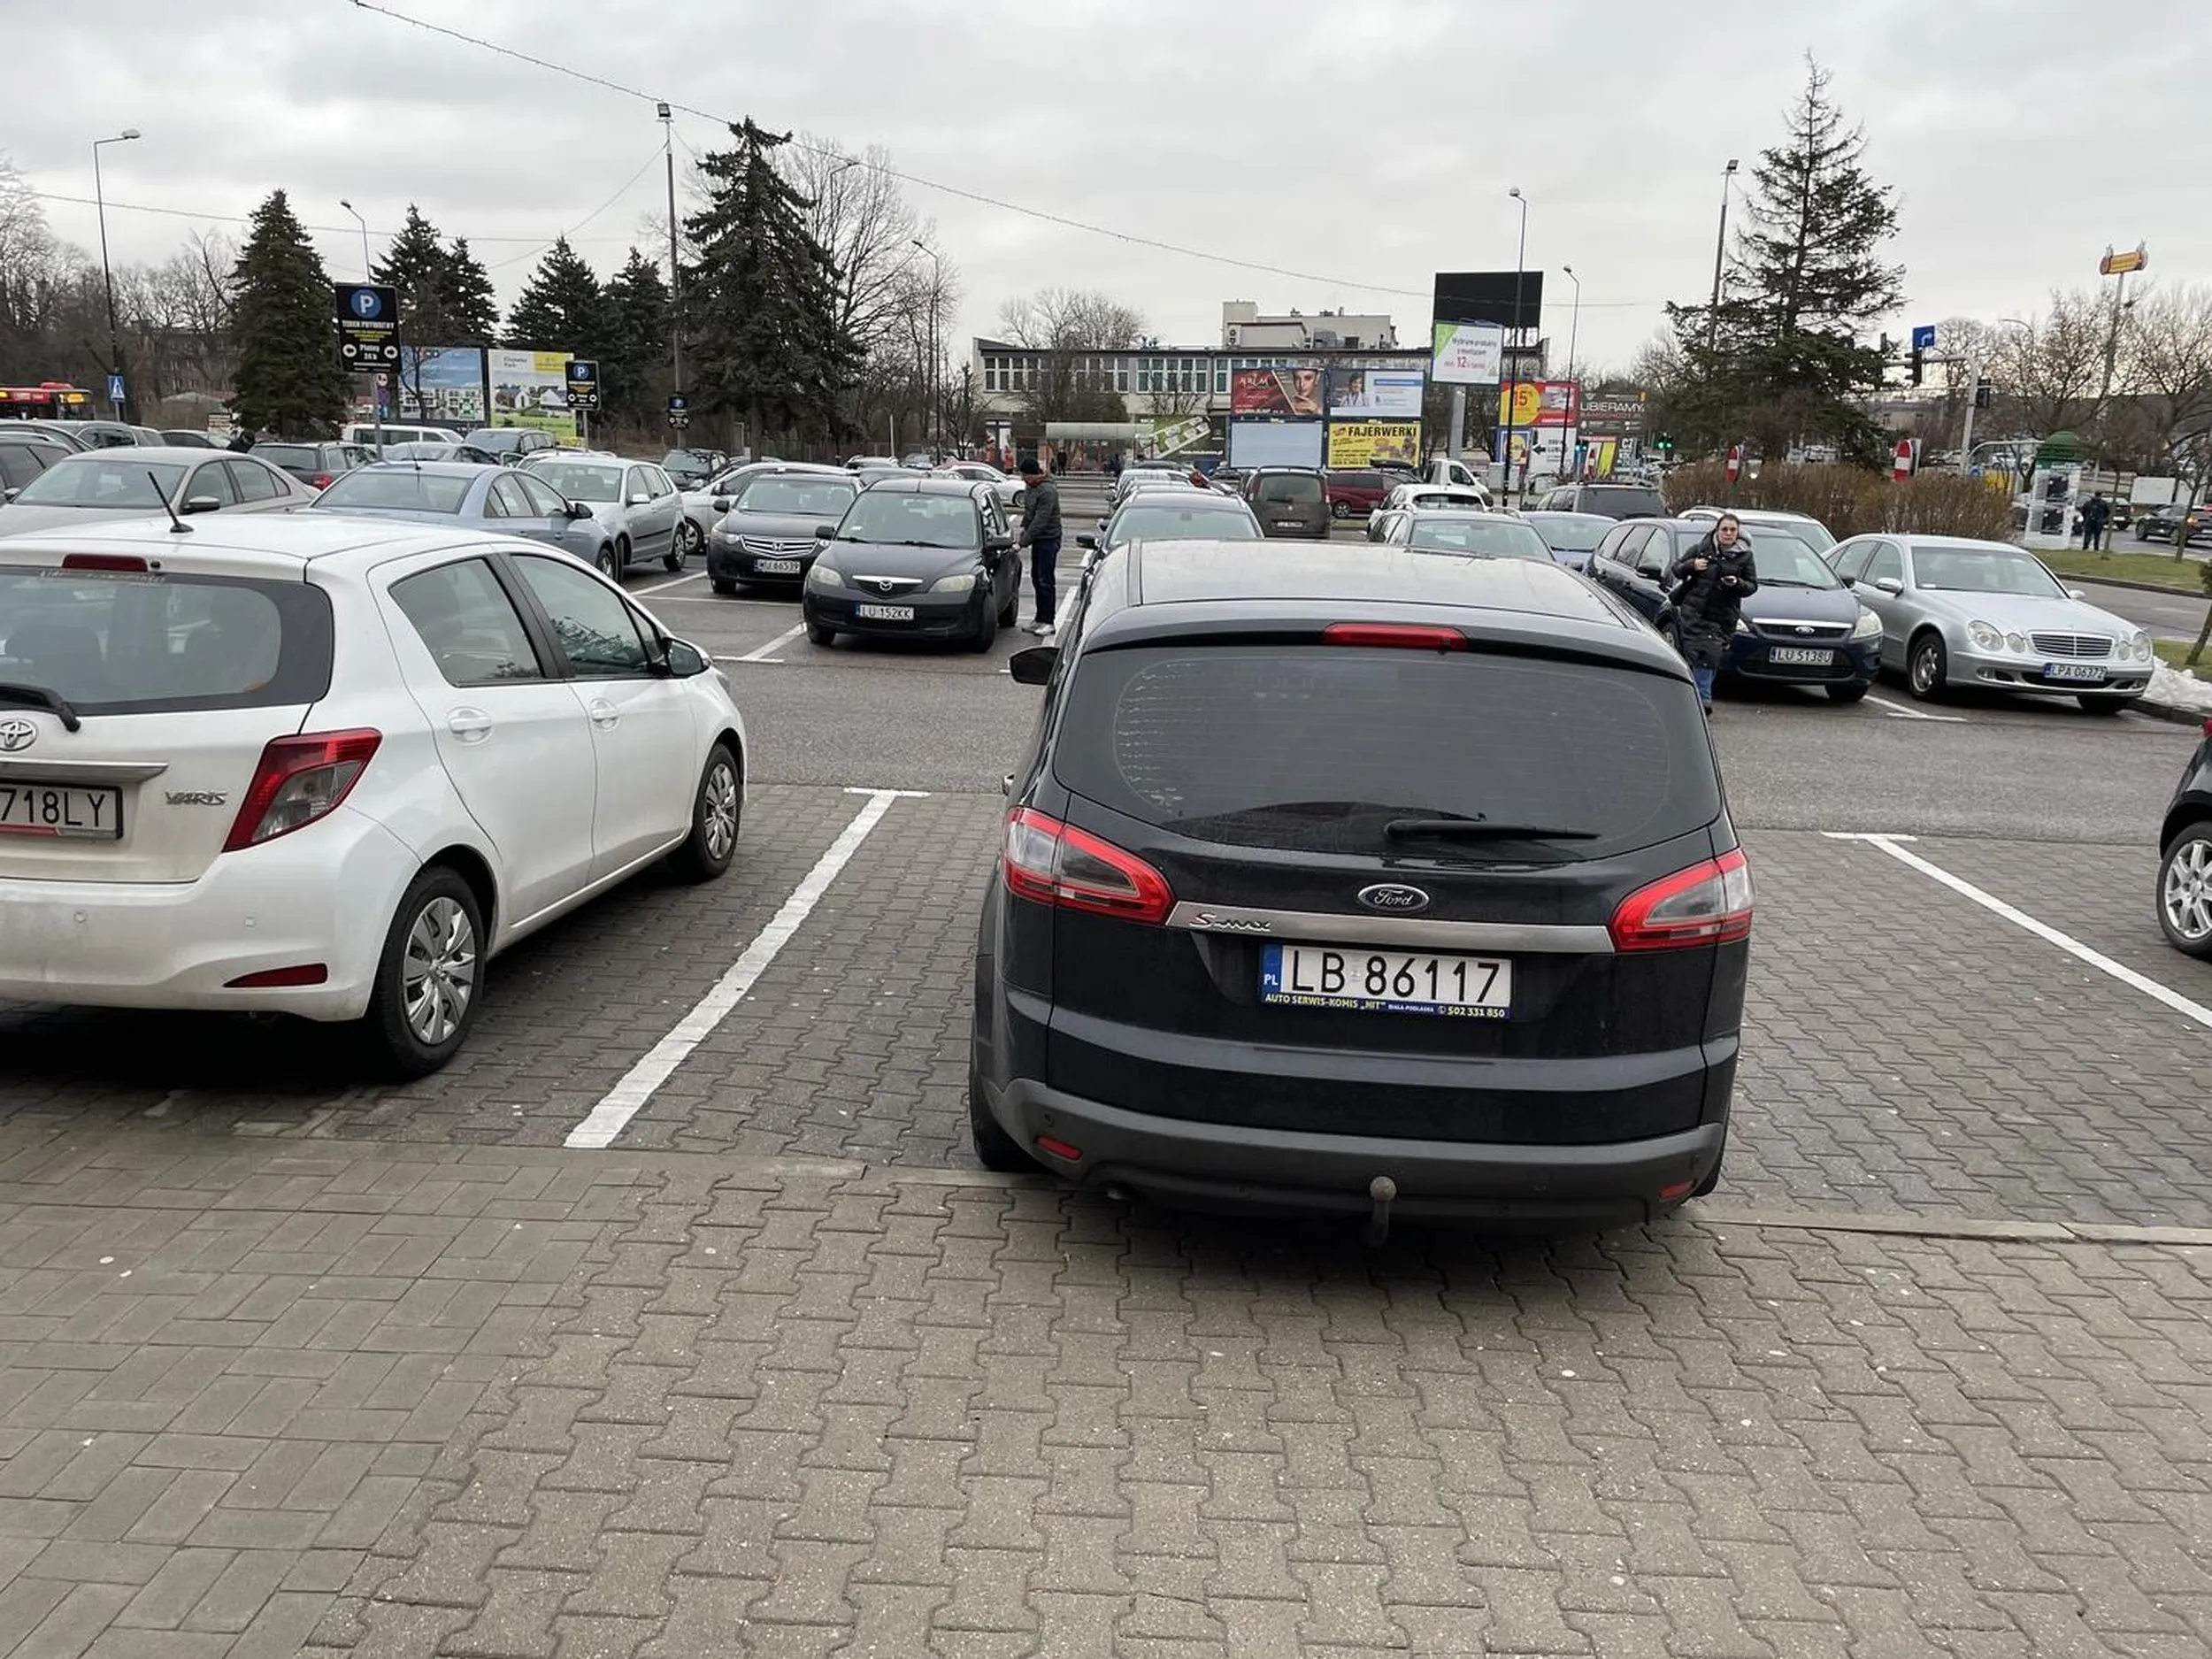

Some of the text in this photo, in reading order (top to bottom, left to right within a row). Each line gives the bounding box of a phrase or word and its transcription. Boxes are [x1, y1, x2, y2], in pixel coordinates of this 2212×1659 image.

[1348, 426, 1417, 437] FAJERWERKI
[0, 788, 105, 827] 718LY
[1374, 888, 1414, 906] Ford
[1263, 974, 1279, 985] PL
[1292, 950, 1500, 1003] LB 86117
[1265, 993, 1290, 1003] AUTO
[1448, 1006, 1466, 1016] 502
[1467, 1007, 1485, 1017] 331
[1486, 1008, 1505, 1018] 850
